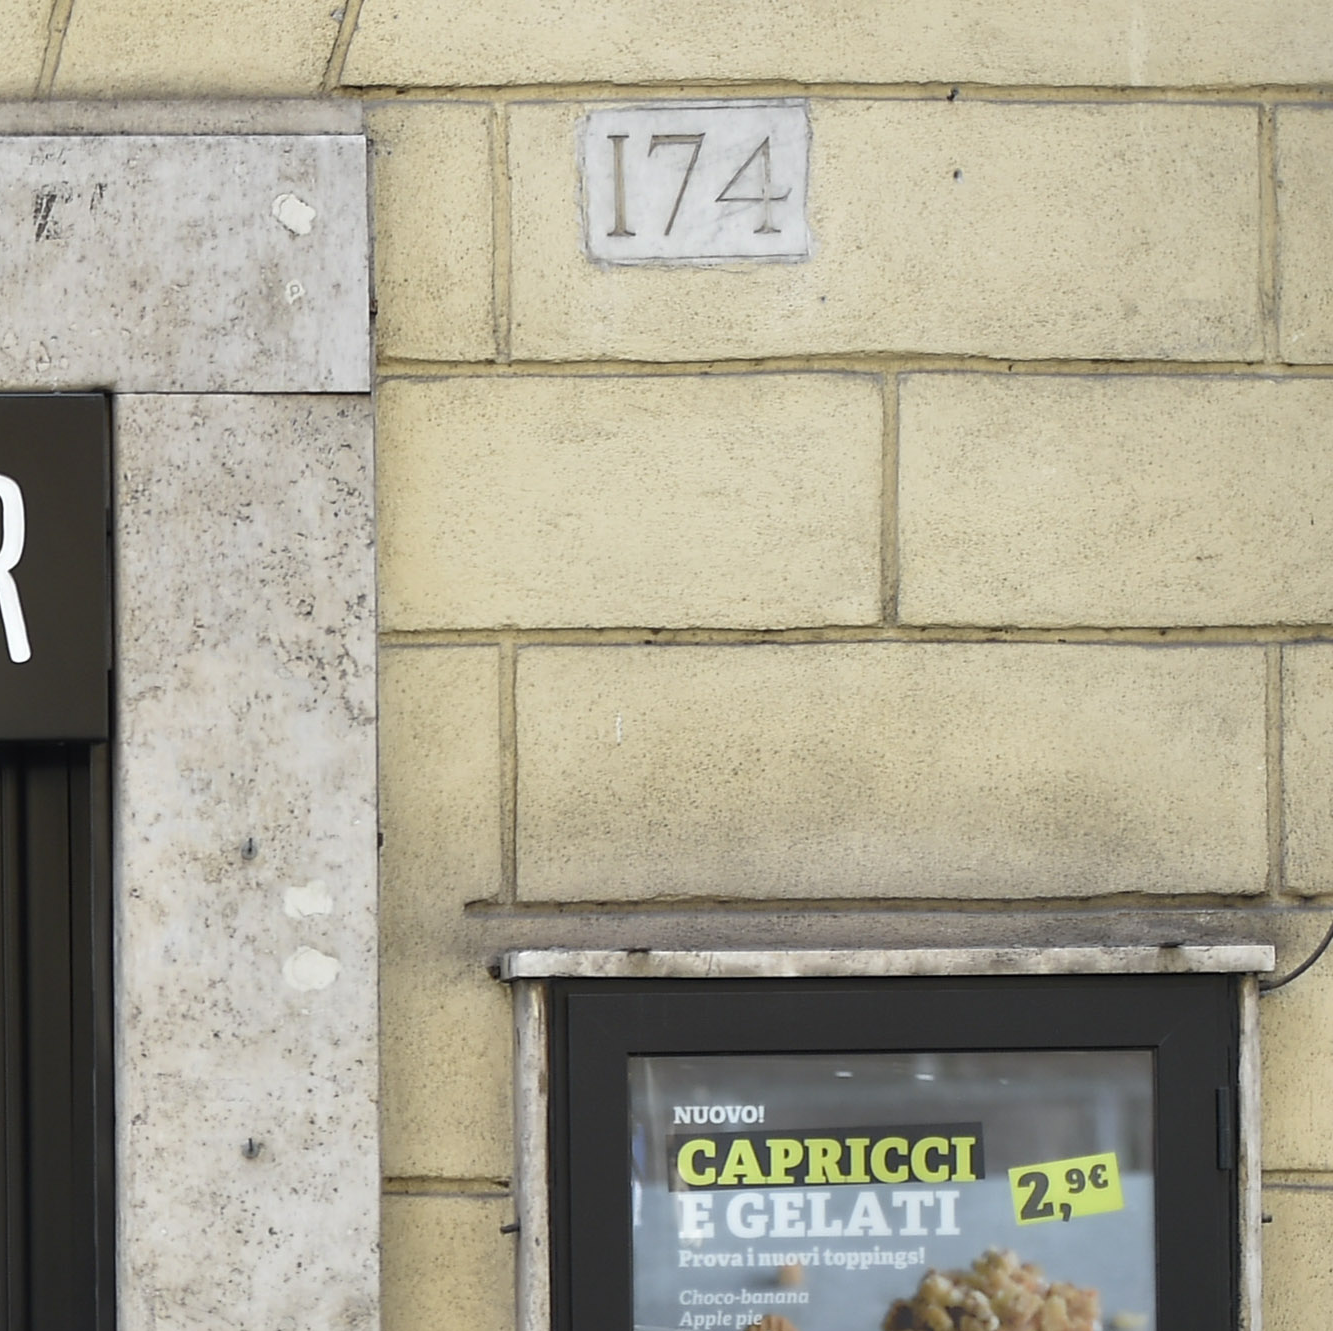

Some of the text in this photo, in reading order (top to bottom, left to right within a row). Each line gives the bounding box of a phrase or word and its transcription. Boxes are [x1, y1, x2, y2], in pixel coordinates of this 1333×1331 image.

[606, 132, 793, 238] 174
[672, 1105, 765, 1125] NUOVO!
[676, 1136, 976, 1187] CAPRICCI
[678, 1190, 961, 1239] E GELATI
[678, 1246, 926, 1270] Prova i nuovi toppings!
[679, 1288, 810, 1306] Choco-banana
[679, 1310, 763, 1330] Apple pie
